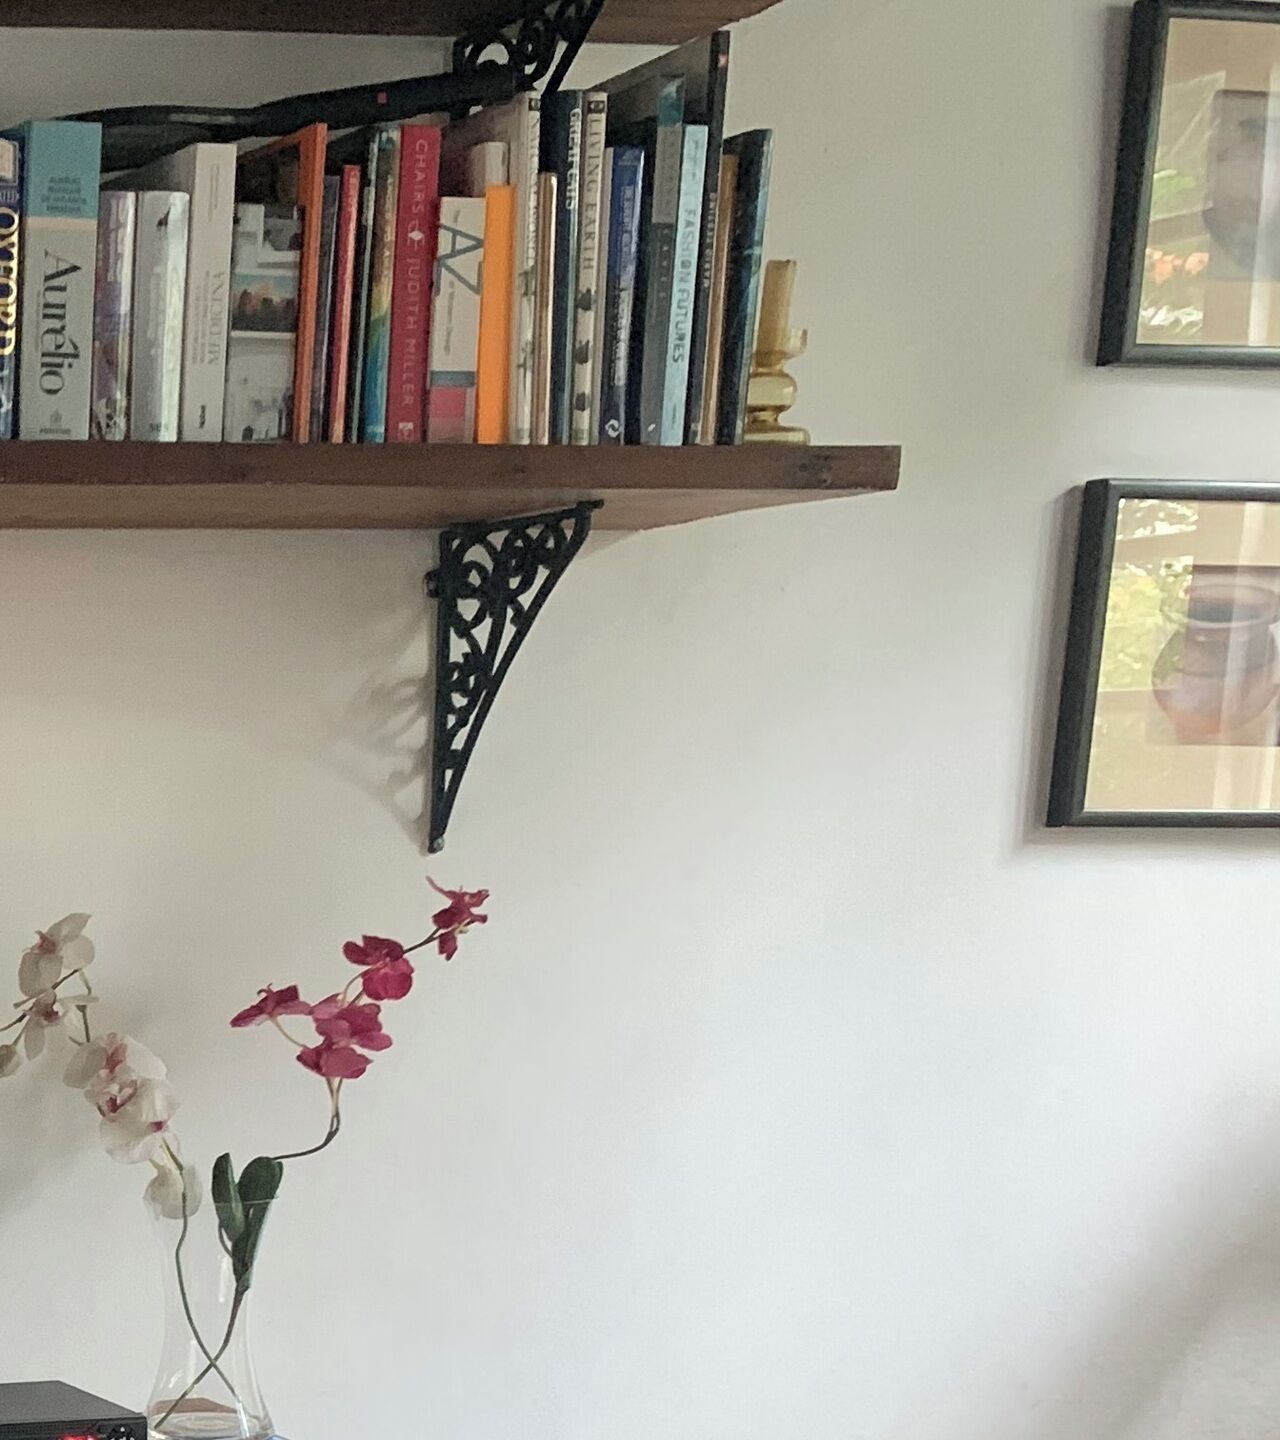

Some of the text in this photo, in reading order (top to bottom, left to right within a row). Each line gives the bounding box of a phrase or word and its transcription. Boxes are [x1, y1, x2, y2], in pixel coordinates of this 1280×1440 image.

[583, 118, 602, 271] LIVING EARTH
[39, 249, 82, 396] Aurélio
[401, 139, 428, 406] CHAIRS JUDITH MILLER
[673, 208, 697, 363] FASHION FUTURES
